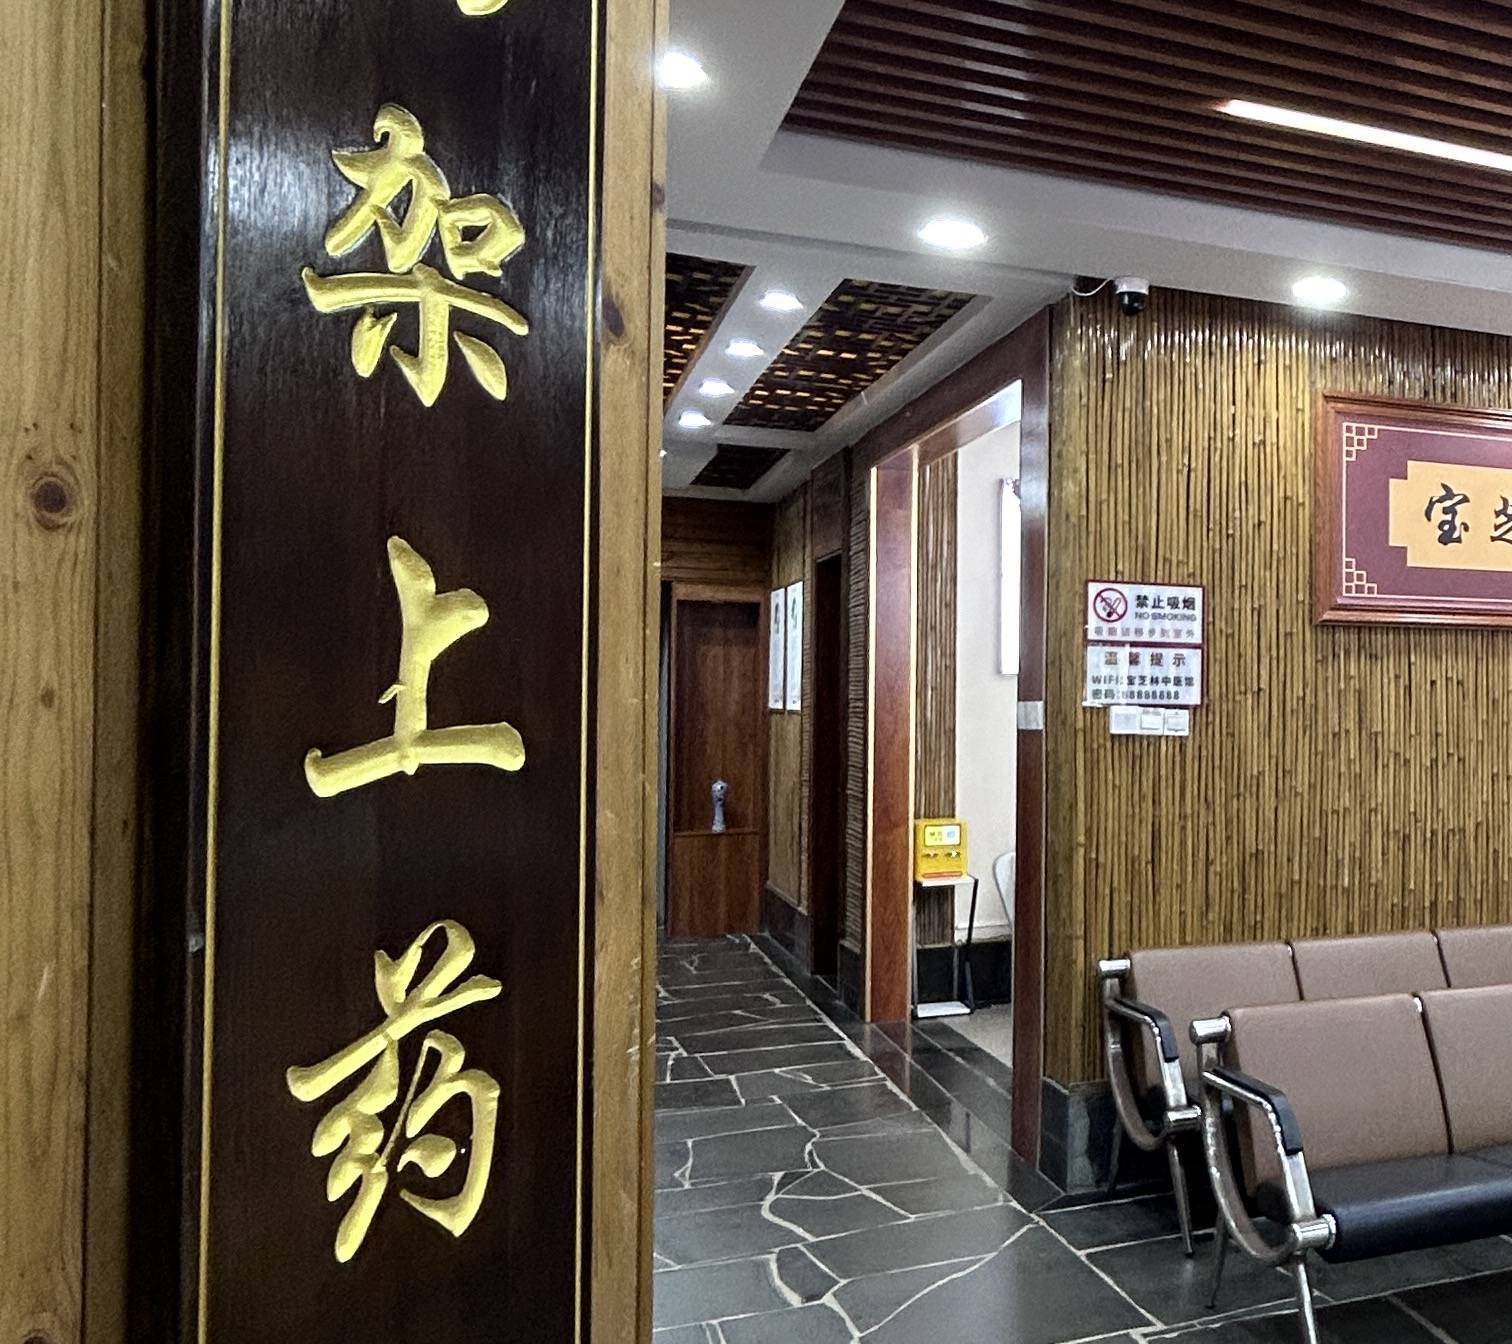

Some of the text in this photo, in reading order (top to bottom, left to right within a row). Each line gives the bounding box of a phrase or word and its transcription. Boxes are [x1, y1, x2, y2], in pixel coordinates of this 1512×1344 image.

[1136, 594, 1196, 611] 禁止吸烟
[1135, 612, 1197, 622] NO SMOKING
